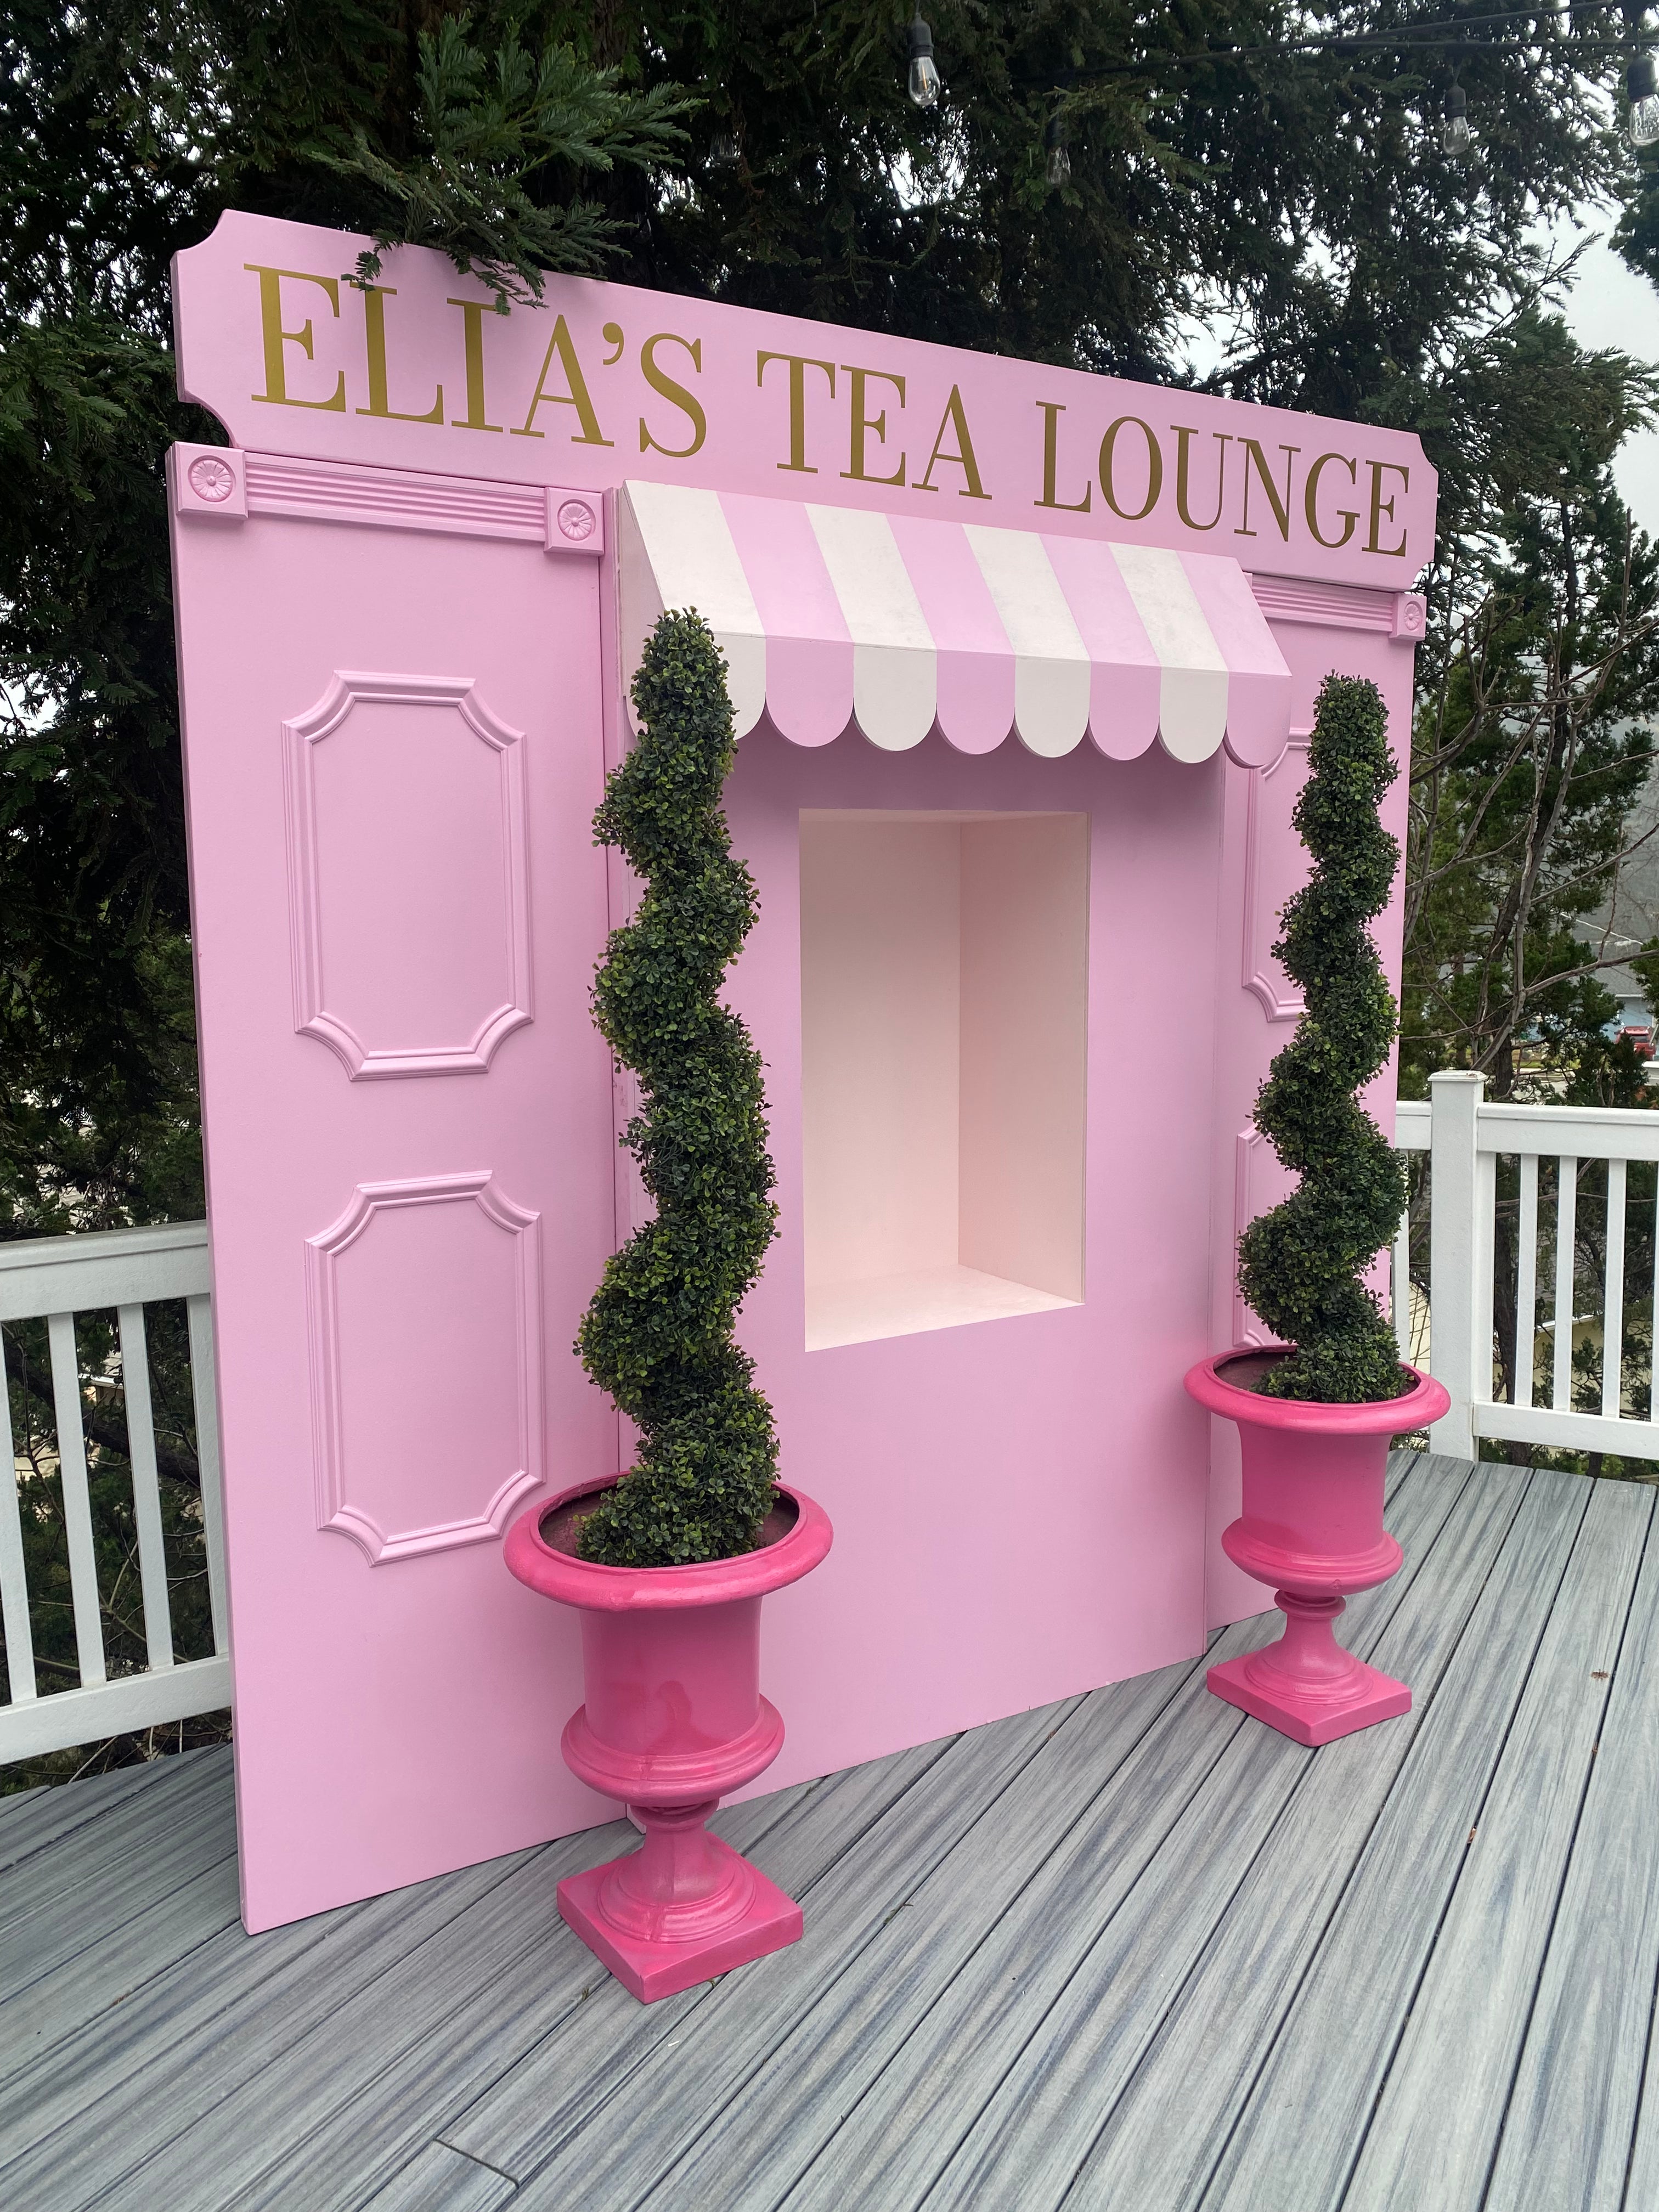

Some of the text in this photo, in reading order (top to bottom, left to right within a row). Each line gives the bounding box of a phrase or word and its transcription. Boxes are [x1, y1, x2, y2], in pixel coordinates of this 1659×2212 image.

[243, 263, 1409, 557] ELIA'S TEA LOUNGE
